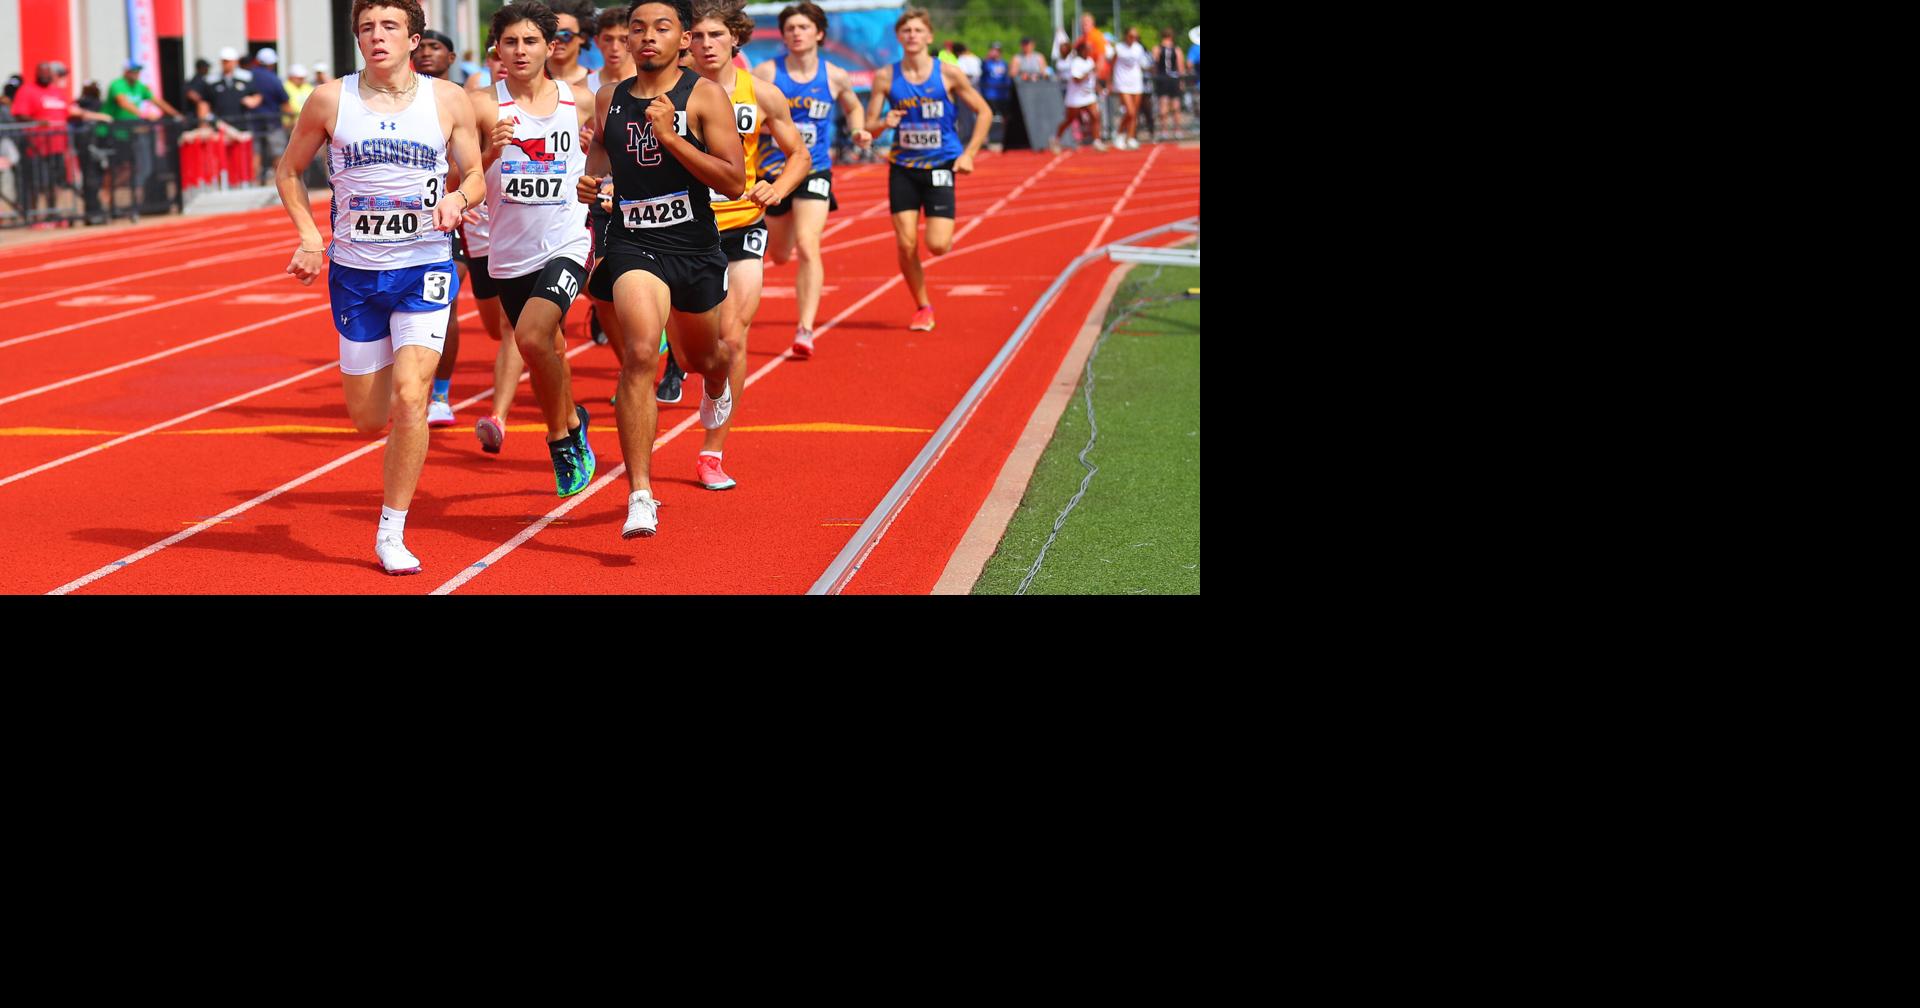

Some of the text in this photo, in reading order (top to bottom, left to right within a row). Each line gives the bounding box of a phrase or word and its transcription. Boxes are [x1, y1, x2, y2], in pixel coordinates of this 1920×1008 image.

[737, 105, 753, 131] 6
[551, 130, 571, 152] 10
[903, 132, 938, 146] 4356
[341, 137, 438, 172] WASHINGTON
[424, 178, 439, 208] 3
[505, 177, 563, 198] 4507
[355, 212, 418, 235] 4740
[628, 199, 688, 226] 4428
[746, 228, 763, 252] 6
[428, 273, 447, 301] 3
[565, 274, 577, 299] 10
